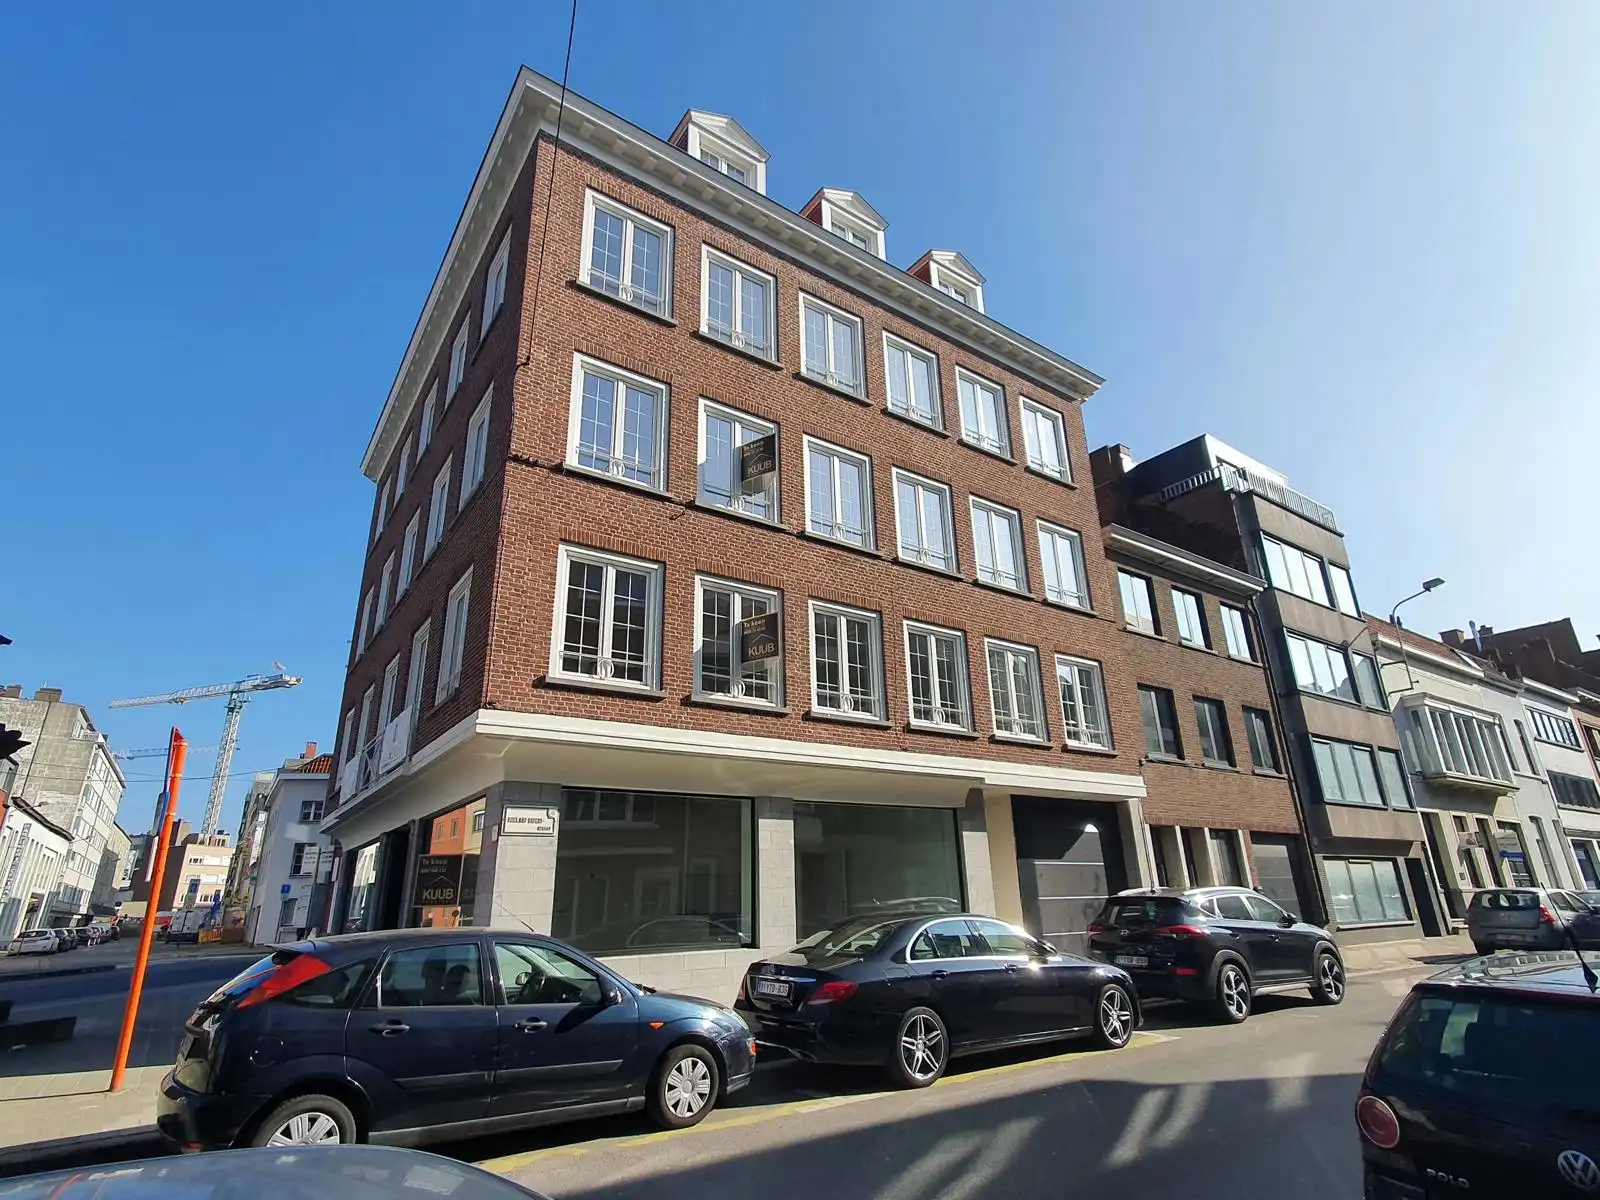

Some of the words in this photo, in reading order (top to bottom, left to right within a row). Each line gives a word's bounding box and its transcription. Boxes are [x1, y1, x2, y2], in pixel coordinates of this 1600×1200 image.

[748, 460, 772, 474] KUUB
[748, 643, 775, 656] KUUB
[422, 888, 454, 900] KUUB
[1426, 1168, 1470, 1189] POLO
